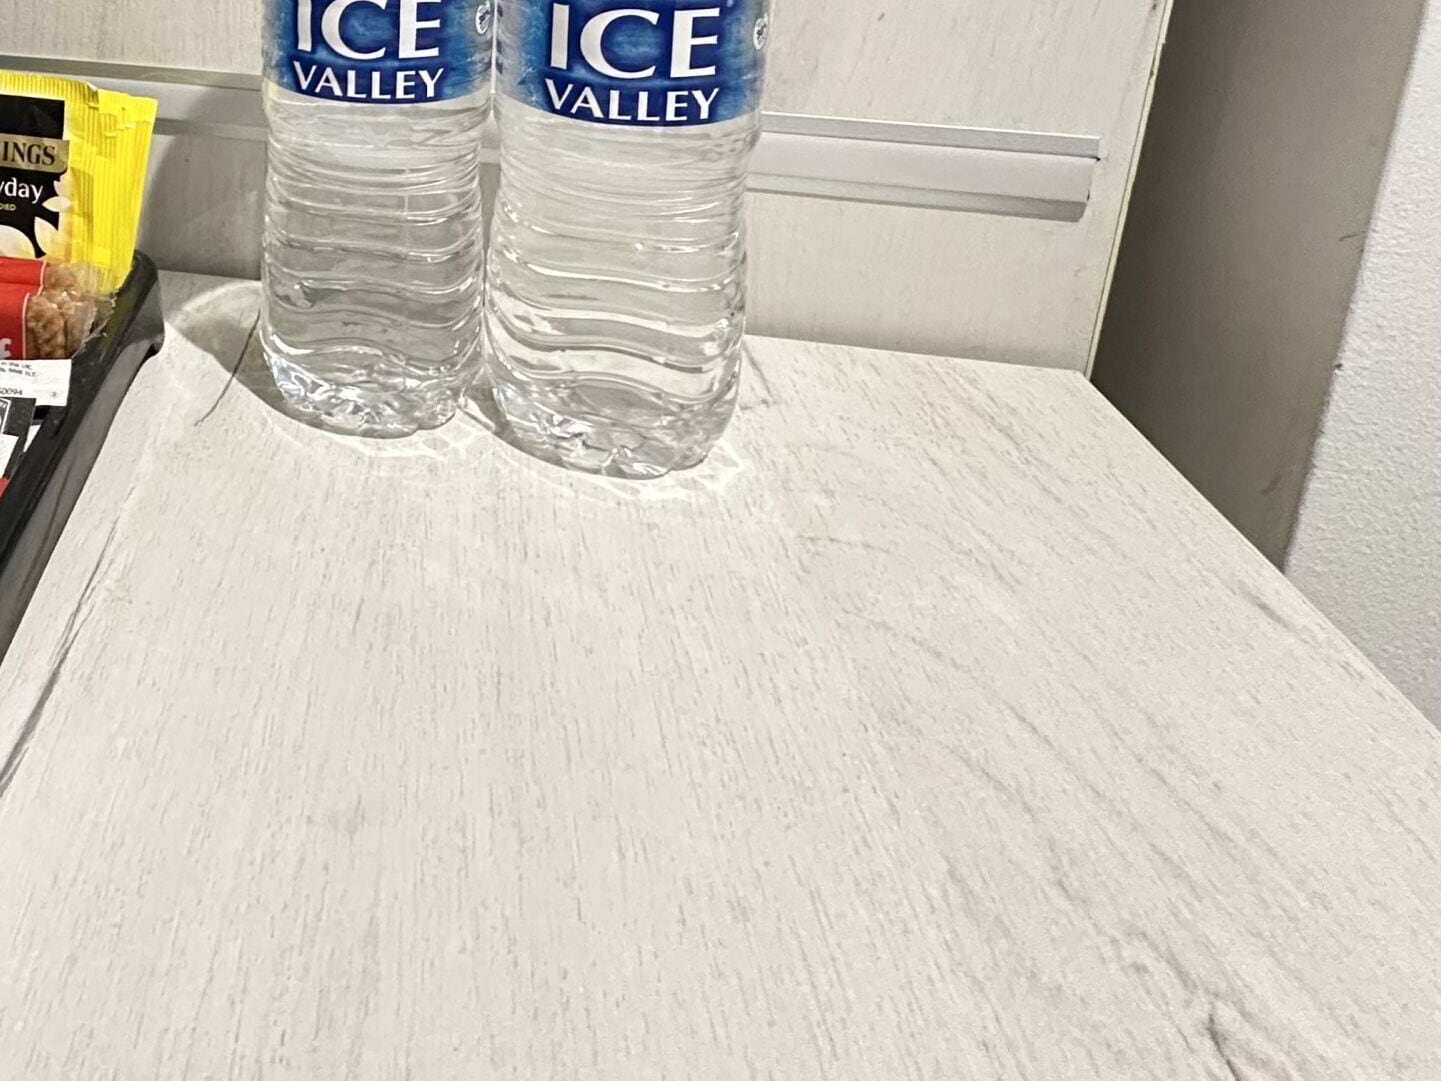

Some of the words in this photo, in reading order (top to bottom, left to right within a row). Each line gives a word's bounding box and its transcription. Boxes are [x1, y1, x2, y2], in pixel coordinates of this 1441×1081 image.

[550, 3, 720, 79] ICE
[292, 61, 445, 100] VALLEY
[545, 77, 720, 122] VALLEY
